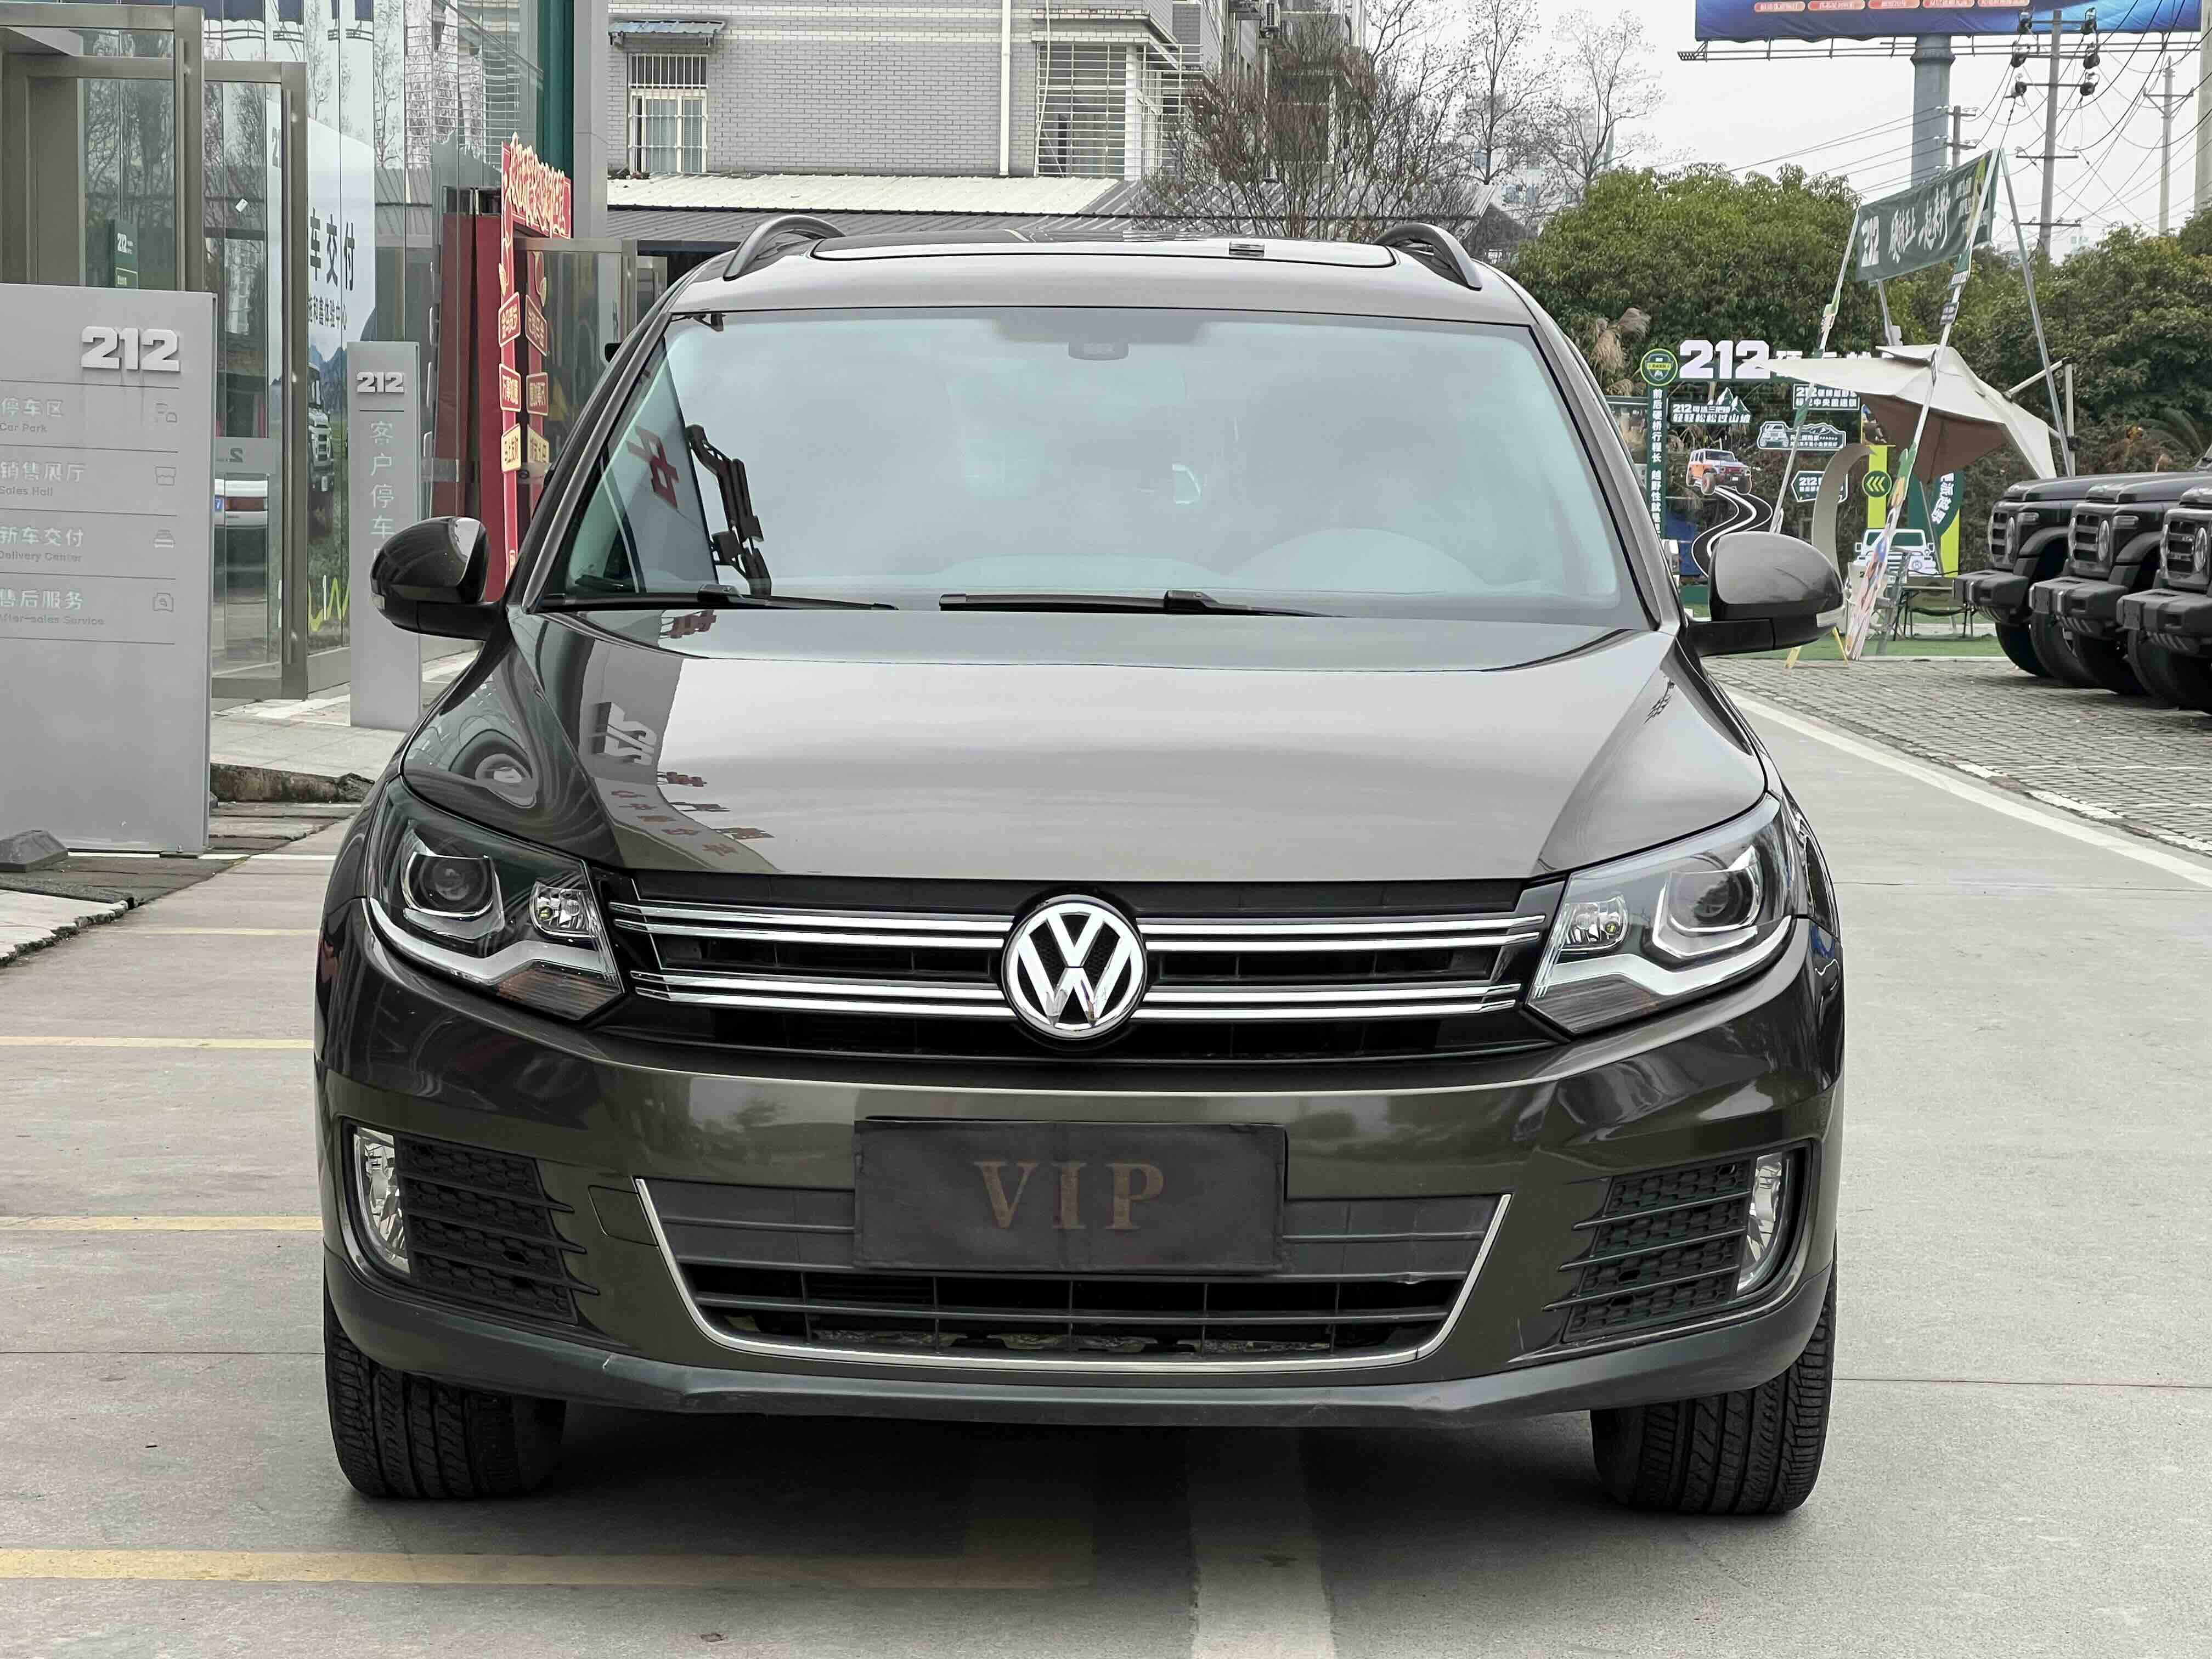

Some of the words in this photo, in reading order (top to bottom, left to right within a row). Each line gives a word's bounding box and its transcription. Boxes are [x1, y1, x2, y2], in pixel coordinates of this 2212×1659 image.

[81, 325, 180, 372] 212
[1680, 340, 1771, 379] 212
[356, 371, 404, 394] 212
[1, 398, 63, 417] 停车区
[0, 461, 86, 482] 销售展厅
[32, 487, 53, 496] Hall
[0, 526, 84, 548] 新车交付
[0, 588, 83, 610] 售后服务
[974, 1161, 1165, 1231] VIP
